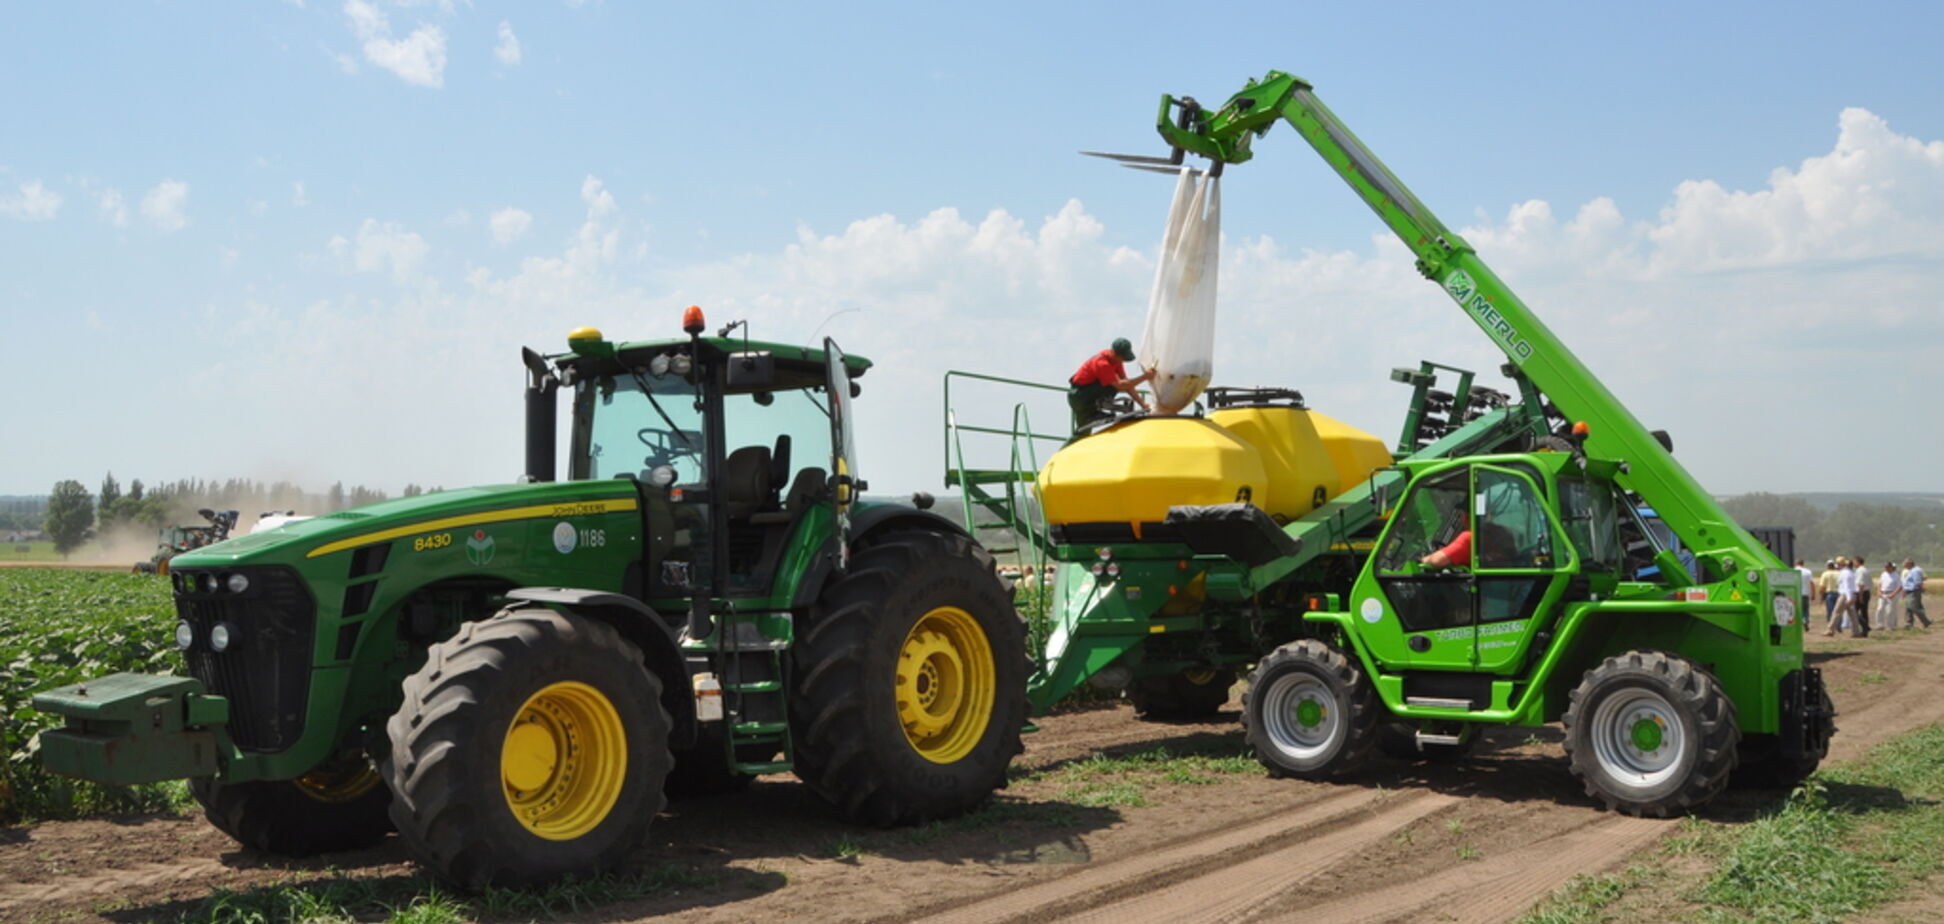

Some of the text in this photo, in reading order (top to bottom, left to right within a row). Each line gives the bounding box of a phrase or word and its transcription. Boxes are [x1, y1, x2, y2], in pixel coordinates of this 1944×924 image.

[1471, 294, 1533, 360] MERLO
[552, 503, 606, 517] JOHN DEERE
[414, 532, 452, 552] 8430
[579, 529, 606, 547] 1186
